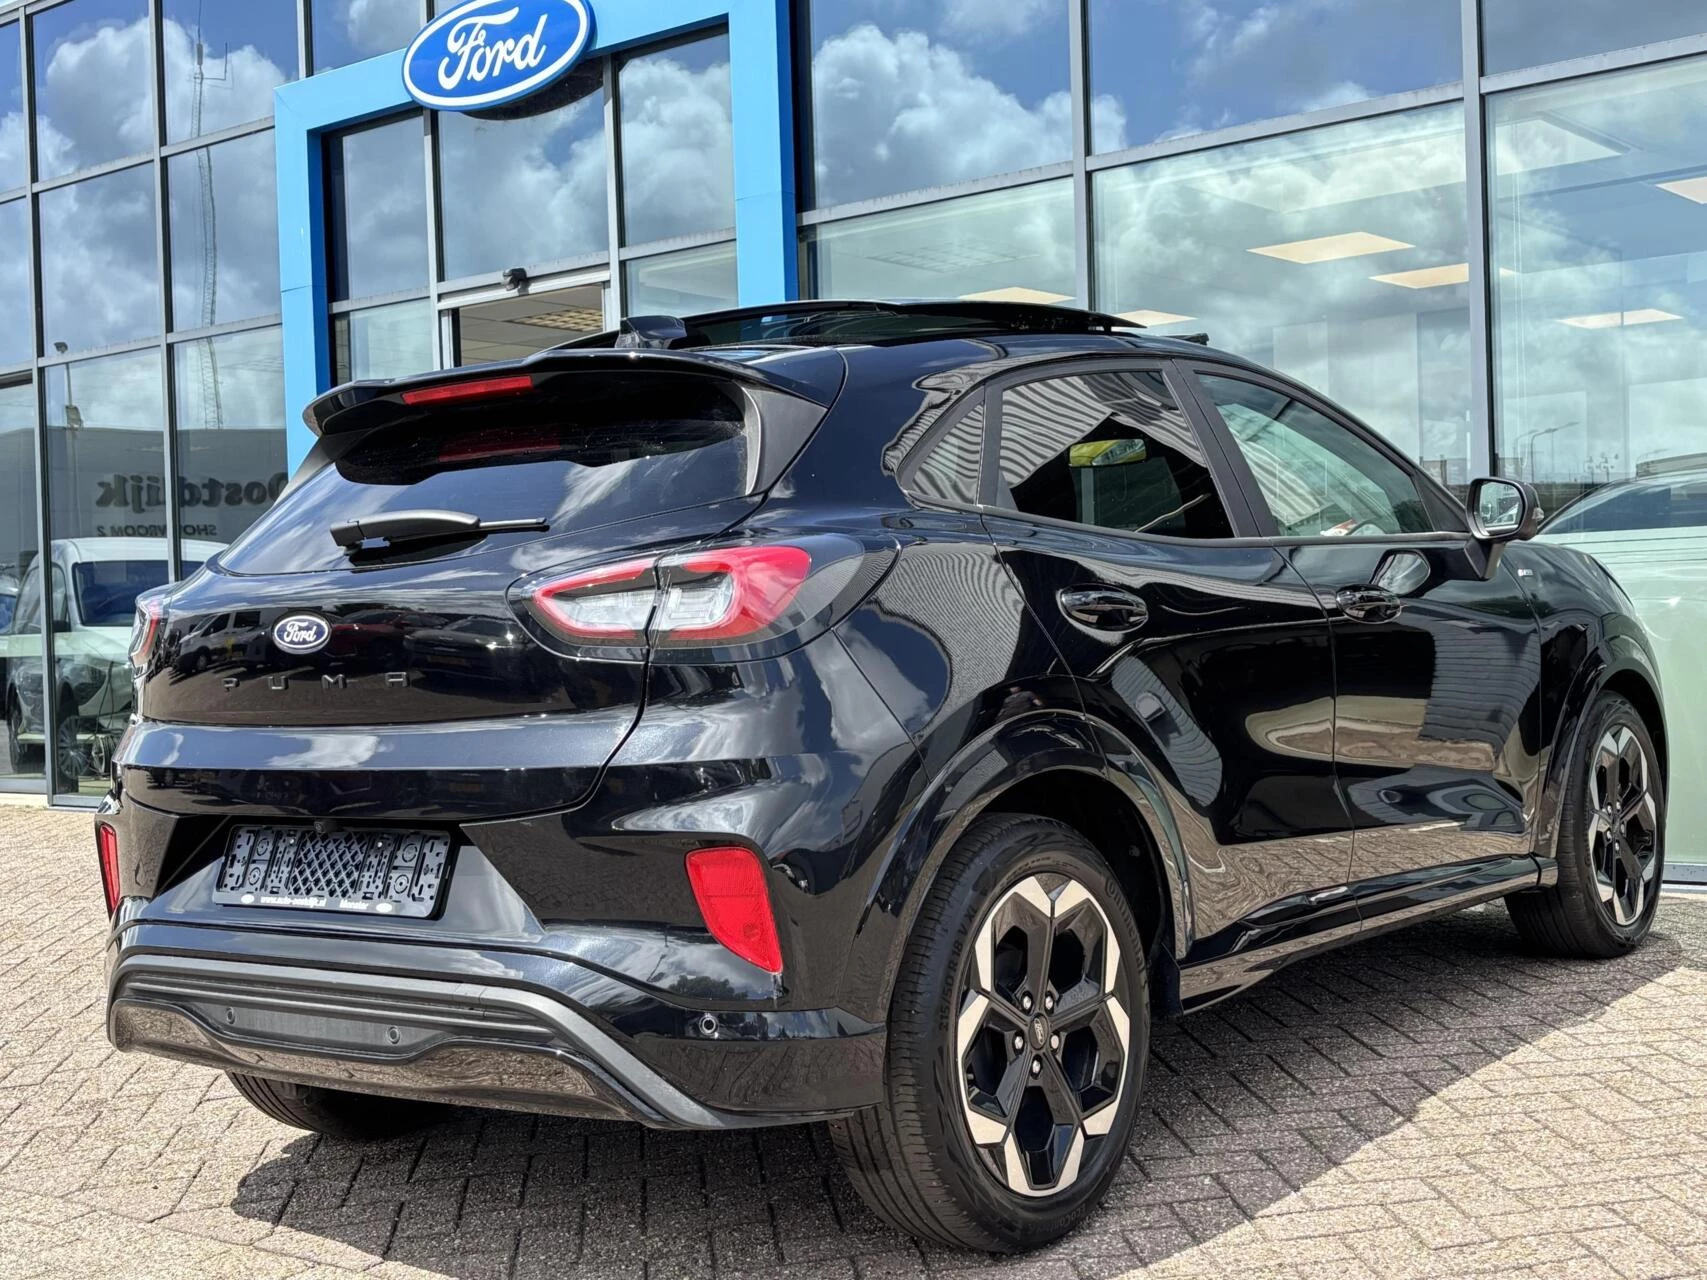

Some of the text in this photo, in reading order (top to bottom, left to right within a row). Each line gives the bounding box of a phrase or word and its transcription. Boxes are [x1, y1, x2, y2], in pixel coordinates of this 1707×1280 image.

[437, 6, 548, 90] Ford
[283, 621, 317, 642] Ford
[222, 671, 411, 691] PUMA
